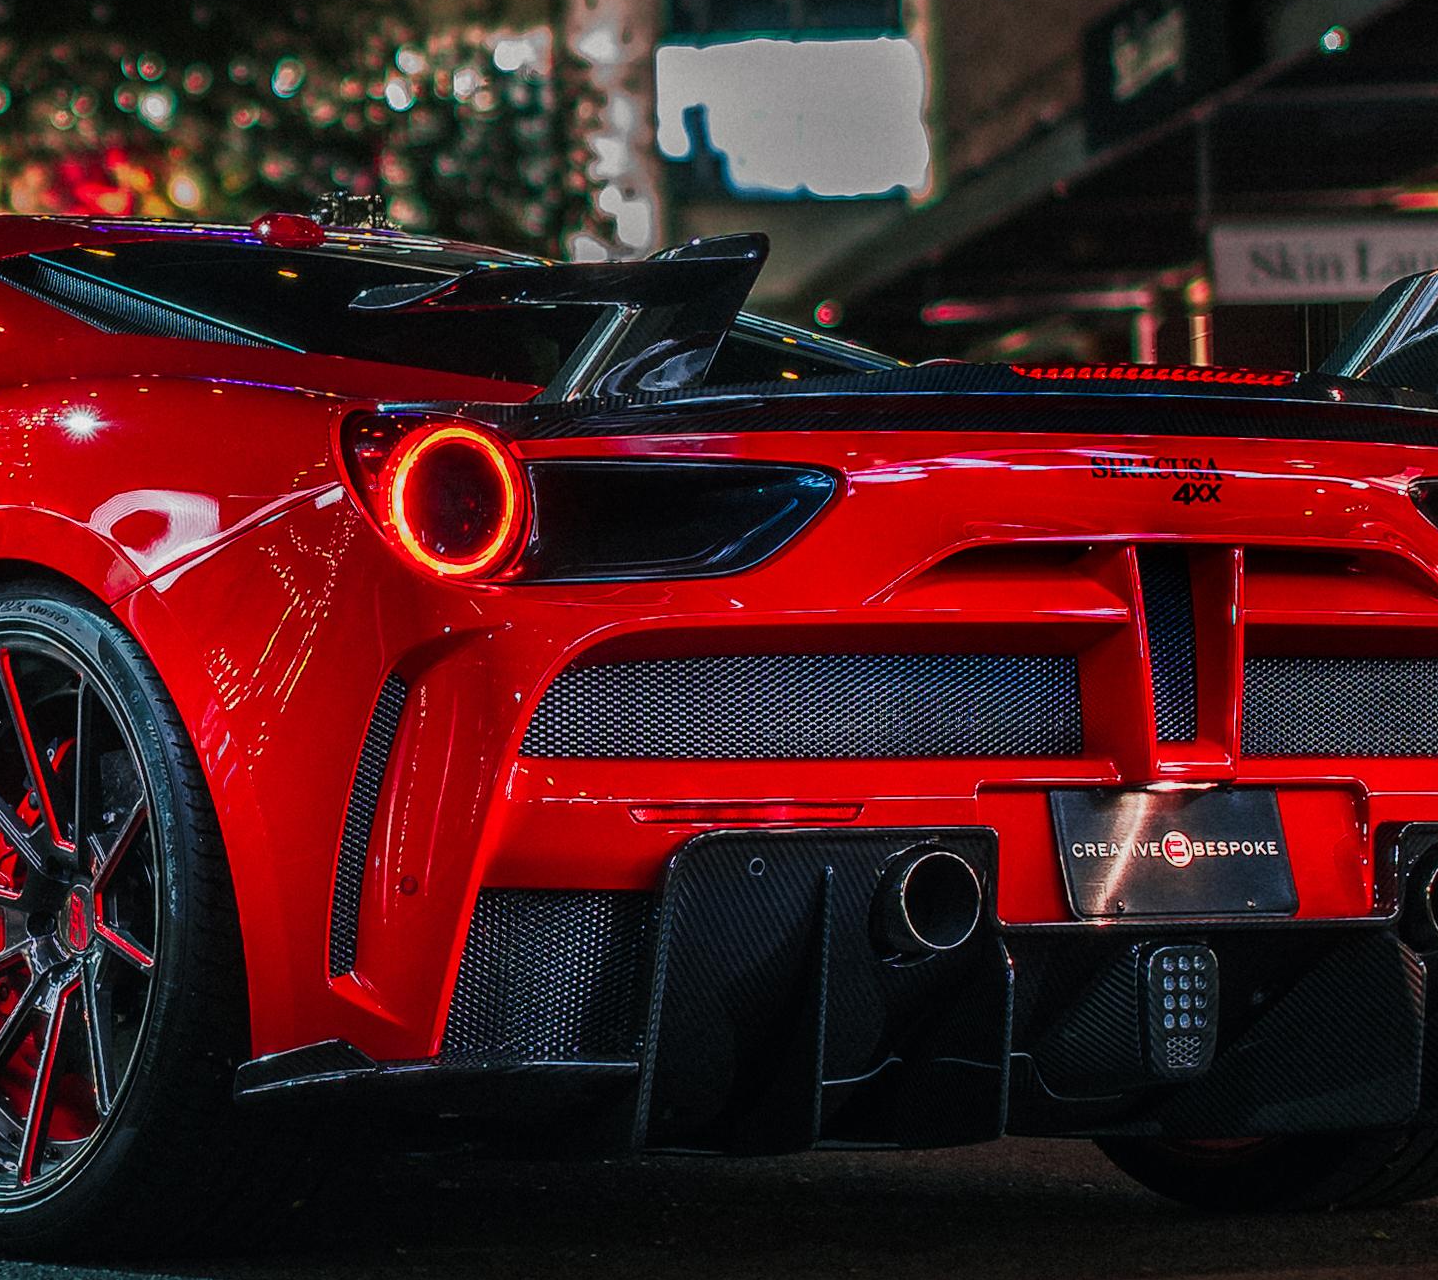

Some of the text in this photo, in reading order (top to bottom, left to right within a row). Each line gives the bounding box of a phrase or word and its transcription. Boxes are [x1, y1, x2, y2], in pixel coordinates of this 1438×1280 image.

[1248, 237, 1346, 284] Skin
[1090, 456, 1223, 481] SIRACUSA
[1172, 482, 1222, 505] 4XX
[1192, 840, 1279, 858] BESPOKE
